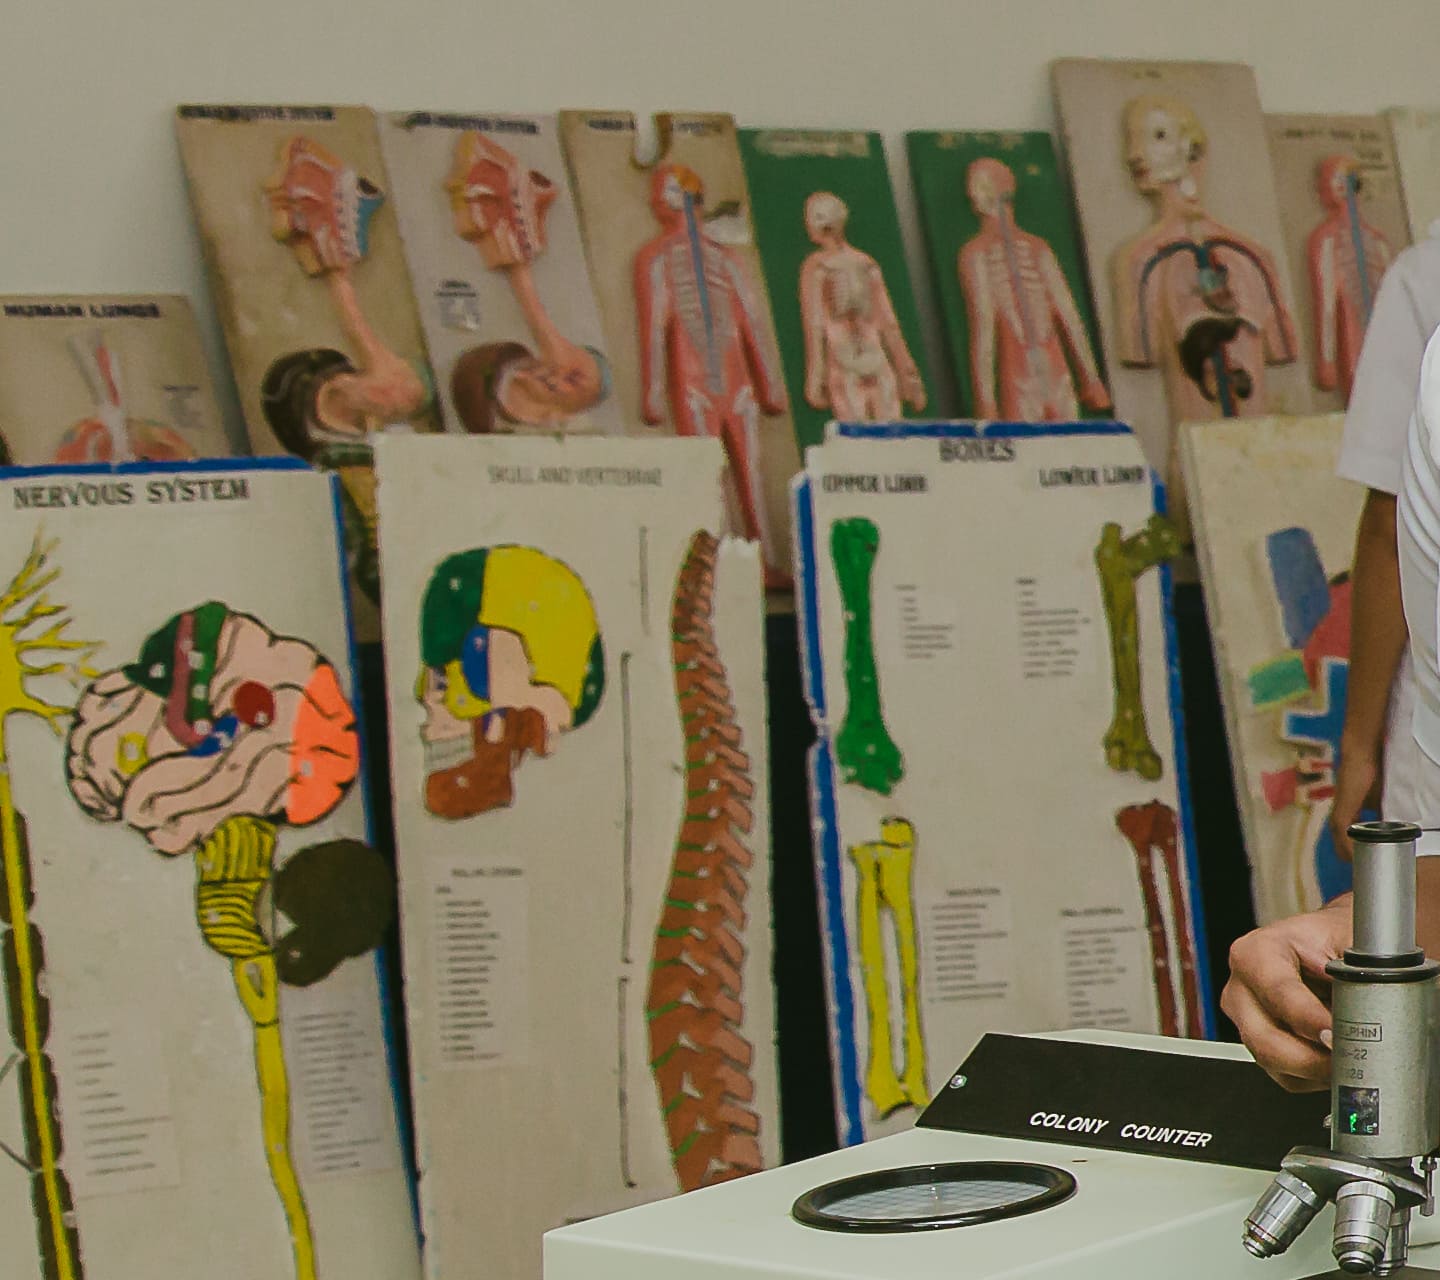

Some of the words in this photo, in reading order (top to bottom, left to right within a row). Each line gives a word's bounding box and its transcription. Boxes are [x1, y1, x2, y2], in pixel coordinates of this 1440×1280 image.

[938, 438, 1016, 462] BONES
[13, 481, 135, 509] NERVOUS
[146, 475, 250, 504] SYSTEM
[1029, 1111, 1109, 1134] COLONY
[1120, 1123, 1213, 1148] COUNTER
